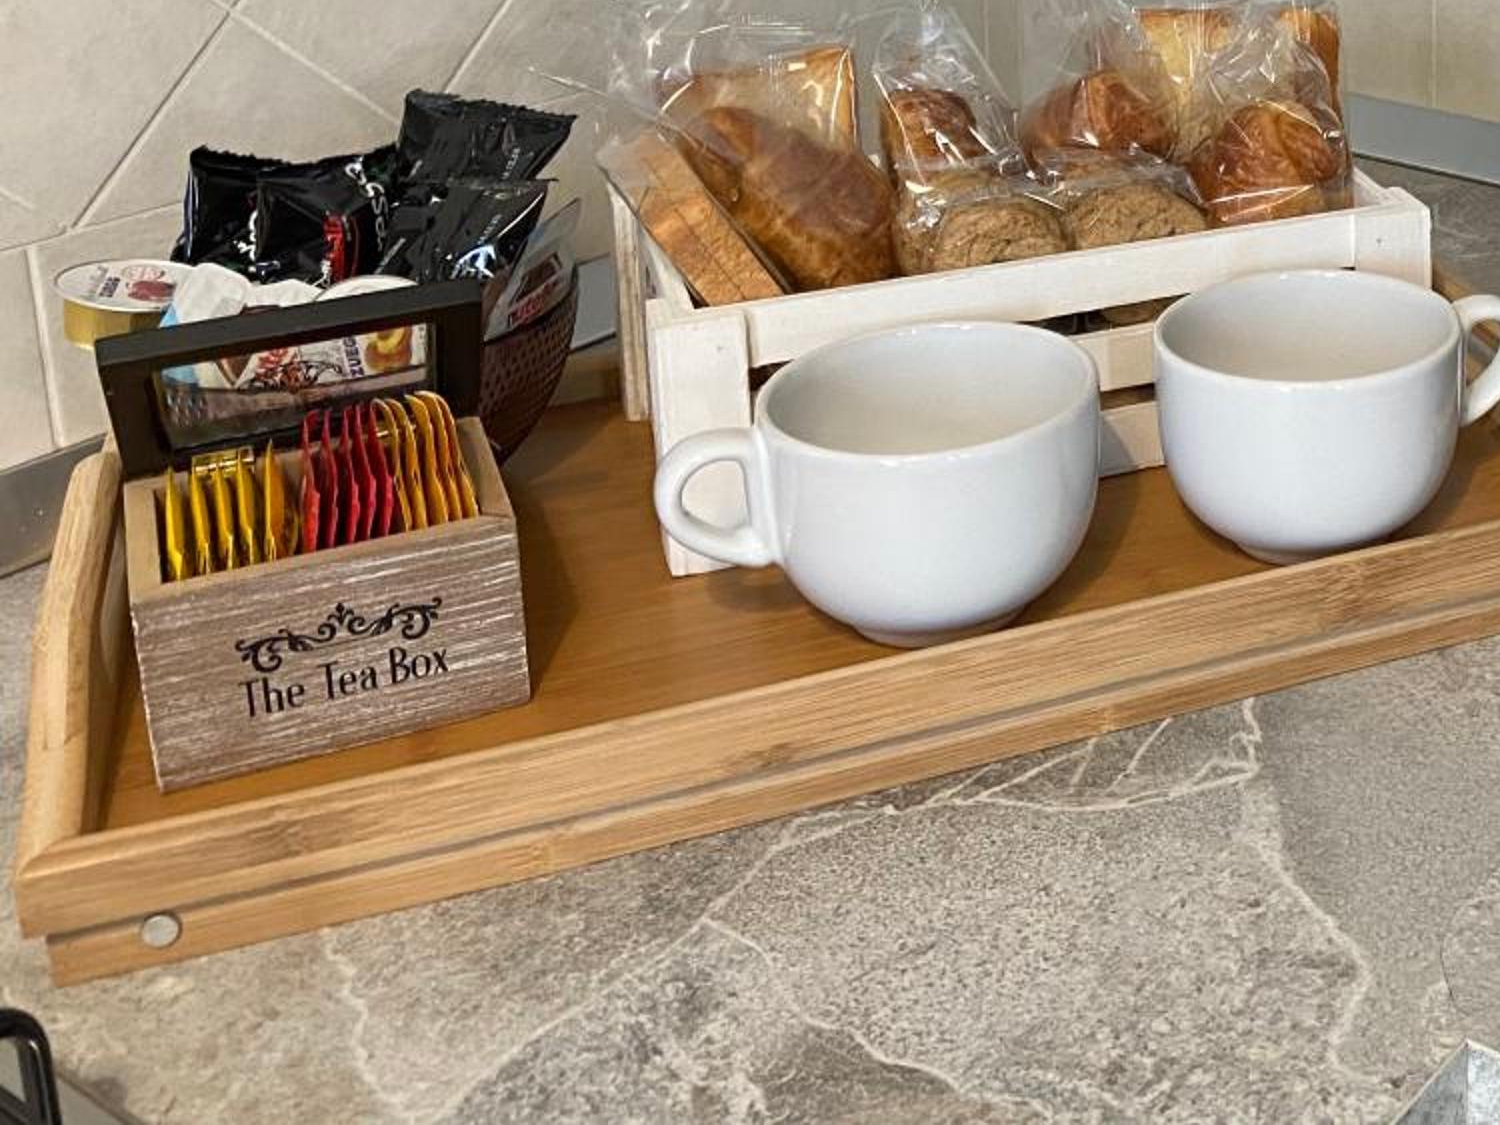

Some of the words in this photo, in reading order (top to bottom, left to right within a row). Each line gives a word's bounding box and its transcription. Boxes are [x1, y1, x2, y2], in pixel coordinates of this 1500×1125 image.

[239, 677, 306, 718] The
[317, 660, 378, 700] Tea
[388, 646, 449, 685] Box
